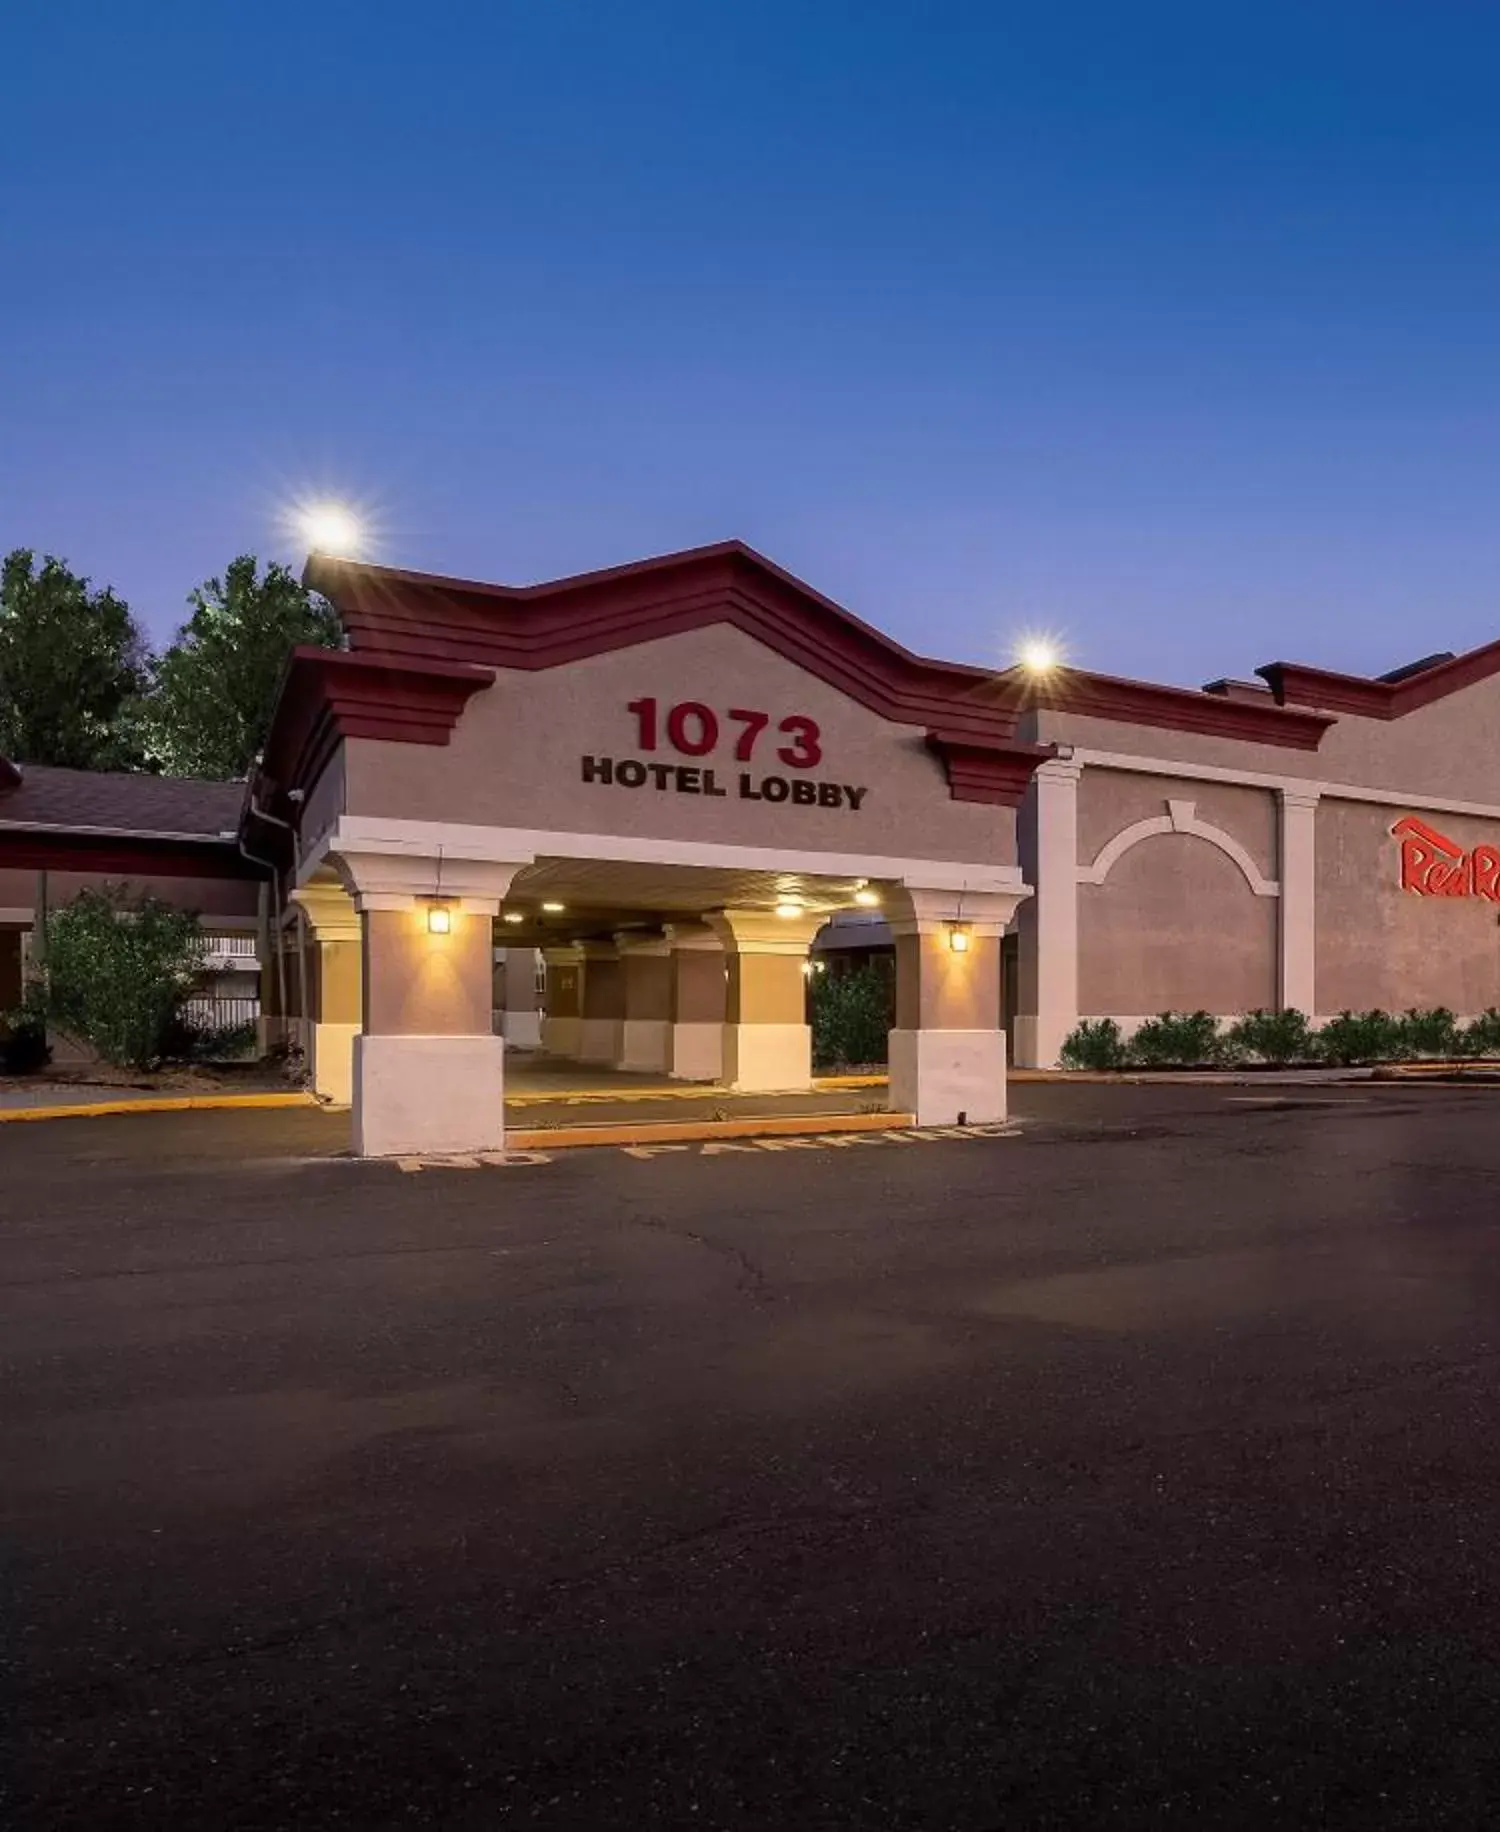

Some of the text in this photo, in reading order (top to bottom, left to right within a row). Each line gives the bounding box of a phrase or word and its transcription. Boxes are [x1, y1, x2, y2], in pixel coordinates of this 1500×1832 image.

[627, 697, 823, 769] 1073
[582, 755, 869, 810] HOTEL LOBBY
[1401, 840, 1471, 897] Red
